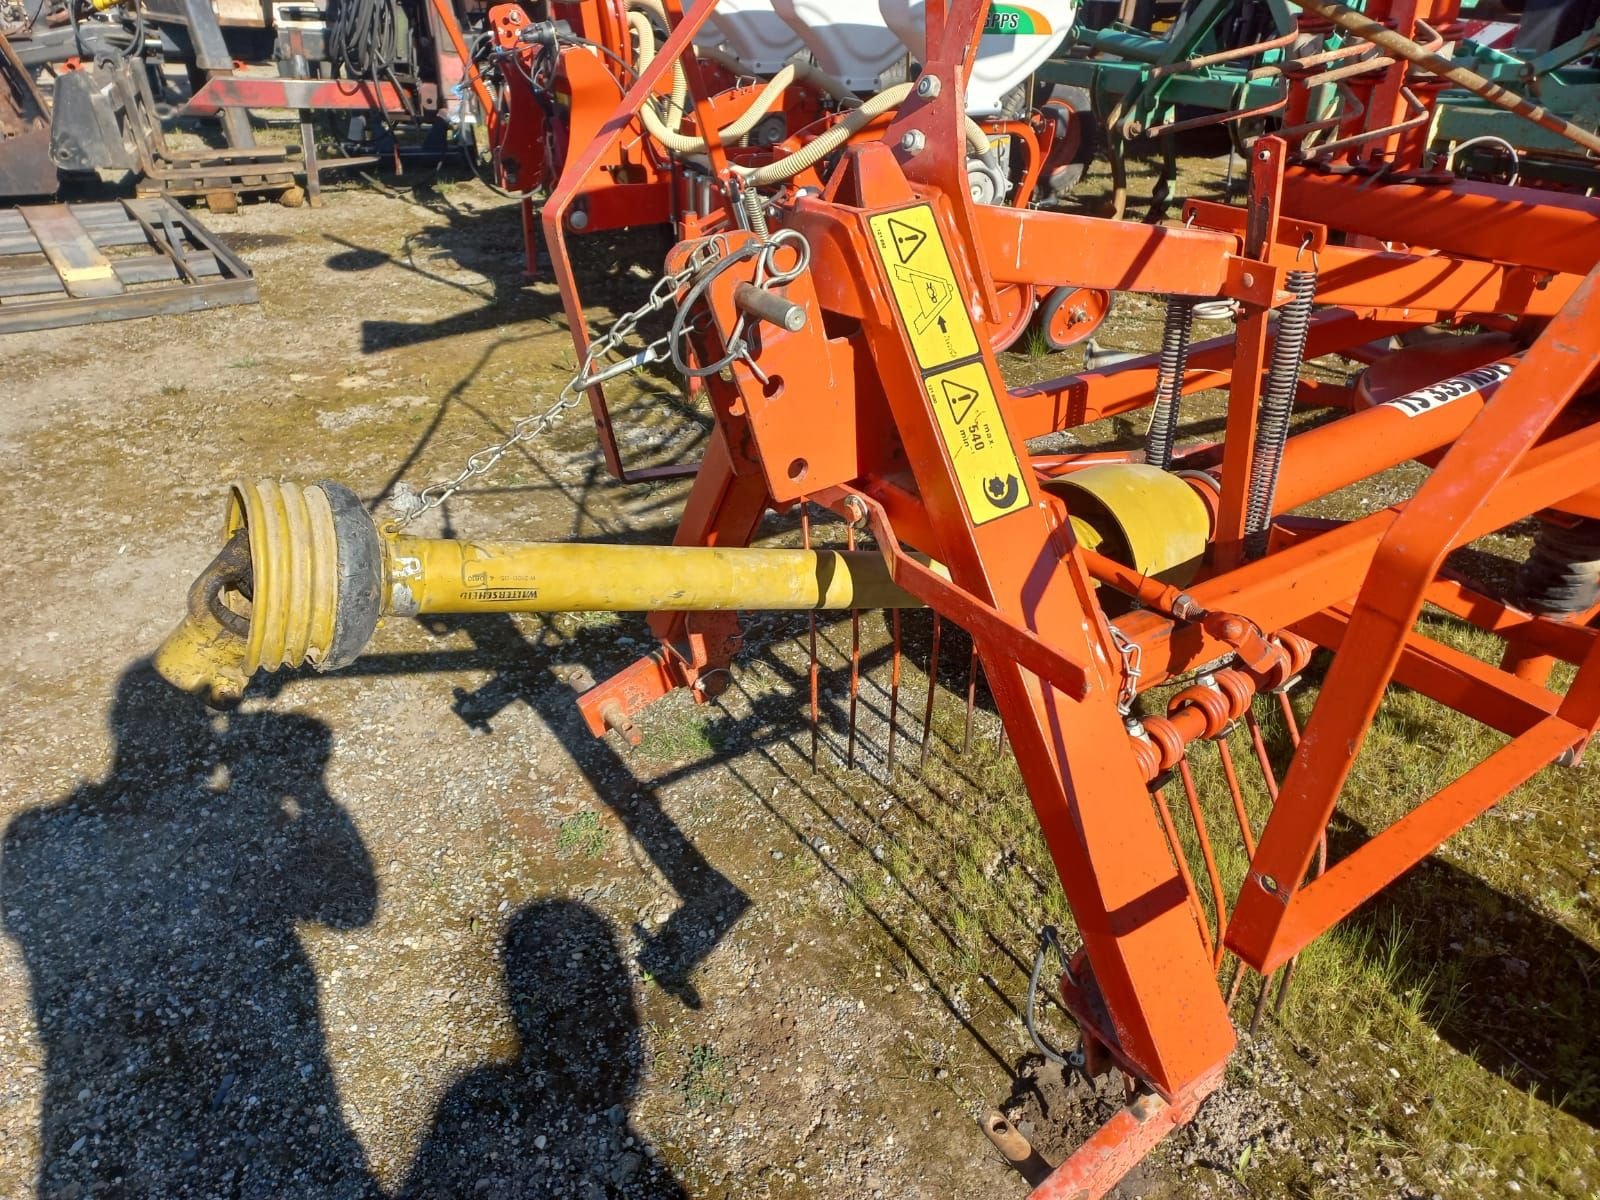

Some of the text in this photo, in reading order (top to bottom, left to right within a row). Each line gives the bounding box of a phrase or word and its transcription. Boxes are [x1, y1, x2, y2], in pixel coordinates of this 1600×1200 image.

[1388, 395, 1430, 412] TS
[1416, 379, 1471, 401] 335
[968, 424, 985, 451] 540
[460, 590, 537, 600] WALTERSCHEID
